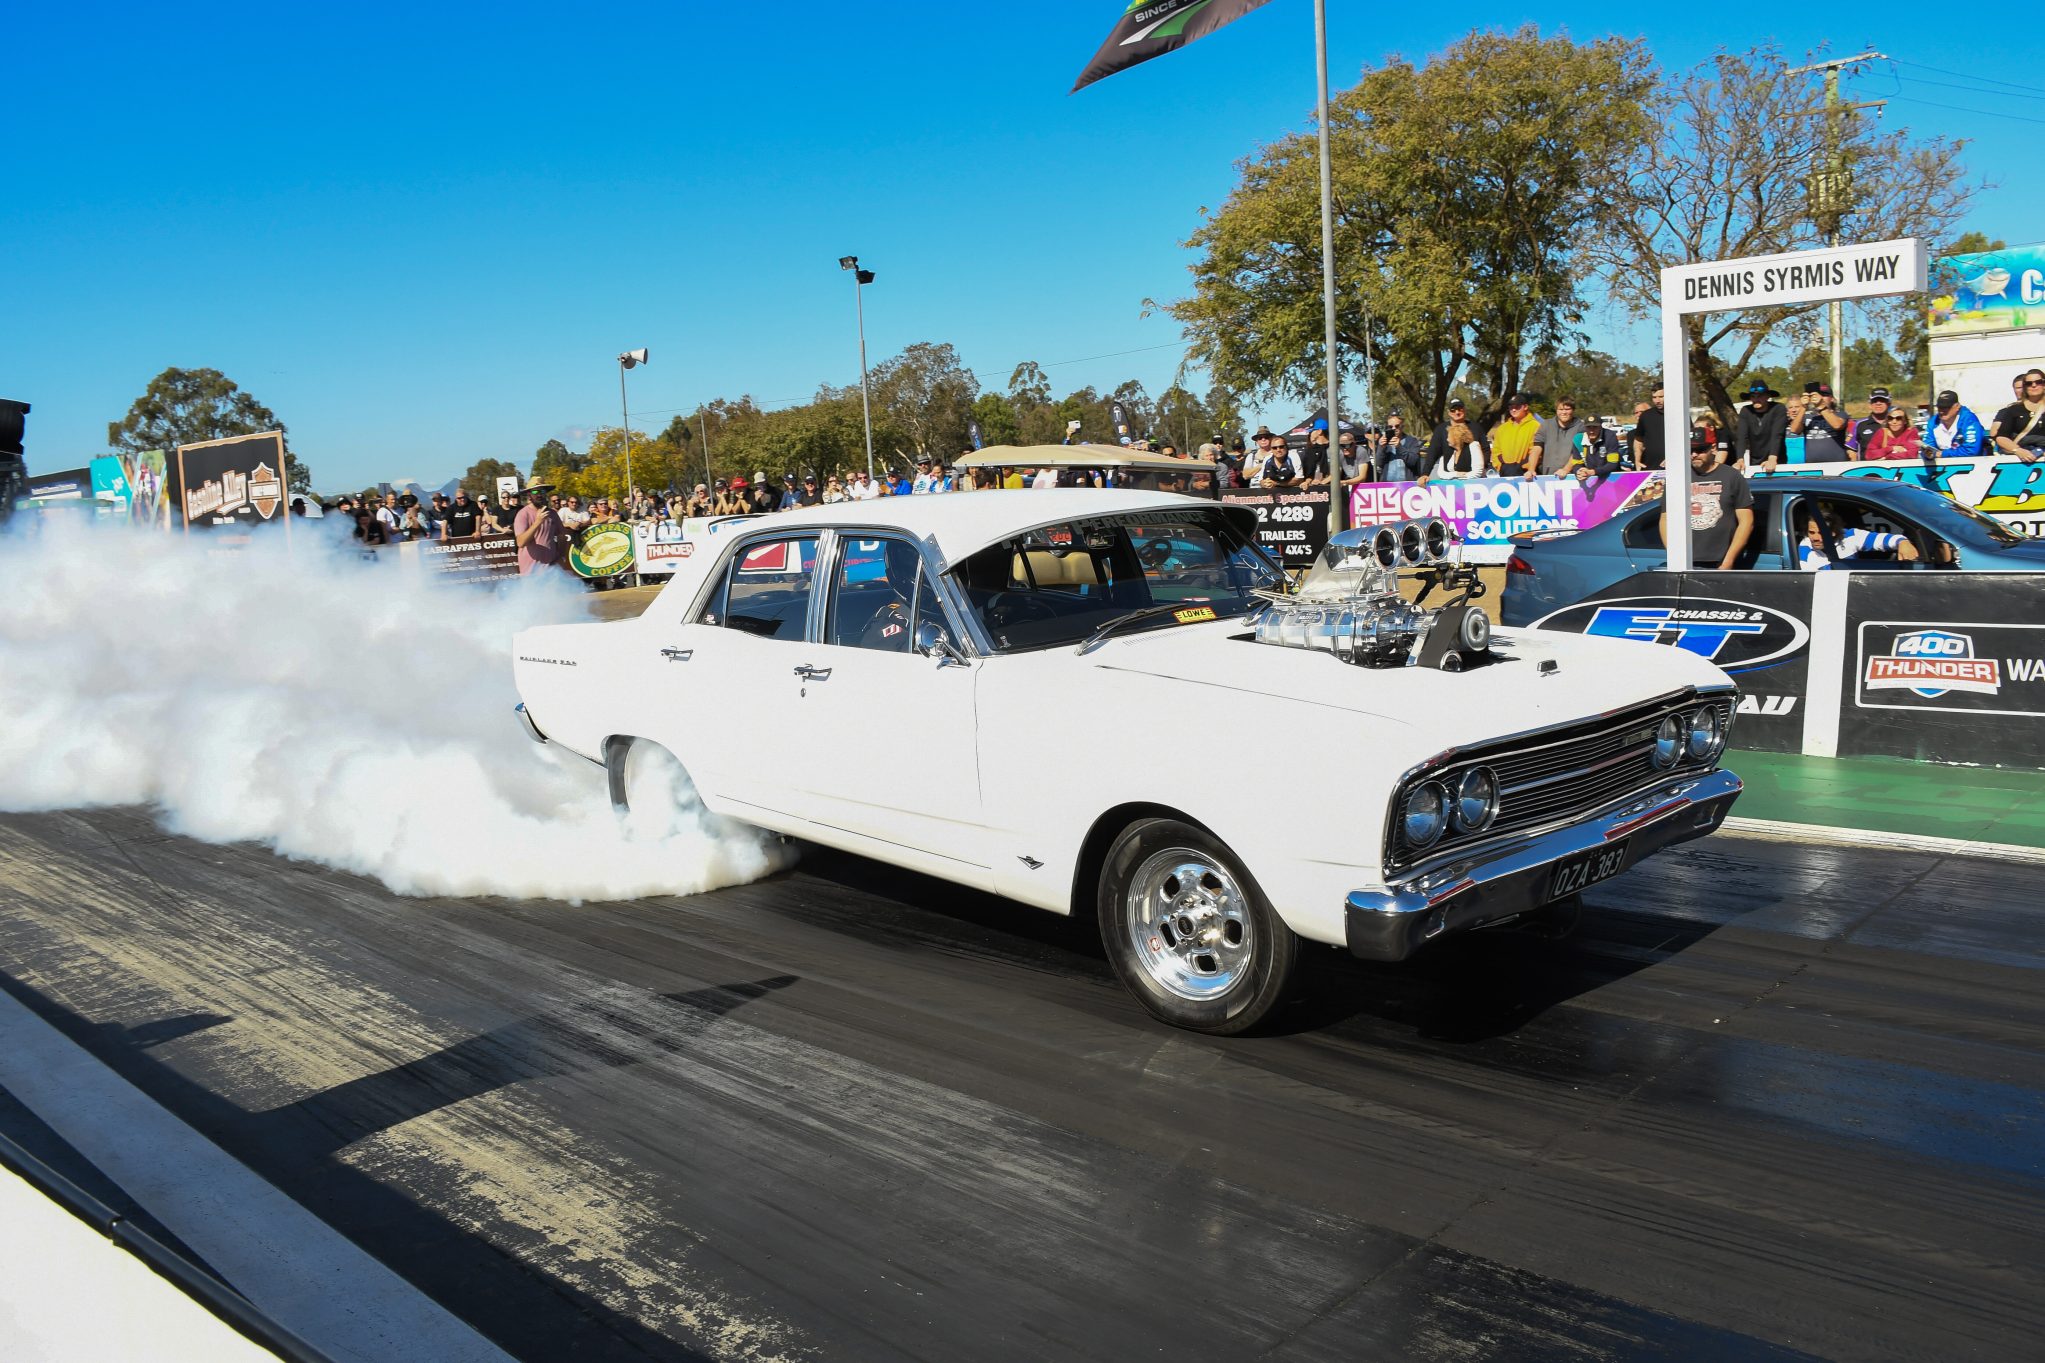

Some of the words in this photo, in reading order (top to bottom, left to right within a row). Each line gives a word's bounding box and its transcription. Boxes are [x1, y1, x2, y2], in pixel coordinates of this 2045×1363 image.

[1135, 0, 1177, 23] SINCE
[1684, 270, 1755, 301] DENNIS
[1763, 260, 1844, 293] SYRMIS
[1854, 254, 1901, 283] WAY
[2020, 268, 2045, 305] C
[1221, 494, 1275, 505] Alignment
[1276, 491, 1330, 506] Specialist
[1271, 505, 1315, 523] 4289
[1259, 529, 1307, 542] TRAILERS
[483, 539, 516, 550] COFFE
[647, 543, 693, 557] THUNDER
[1284, 544, 1313, 556] 4X4'S
[590, 554, 633, 577] COFFEE
[1181, 608, 1207, 619] LOWE
[1671, 608, 1742, 621] CHASSIS
[1743, 611, 1764, 621] &
[1898, 635, 1965, 656] 400
[1874, 659, 1994, 681] THUNDER
[2005, 657, 2045, 683] WA
